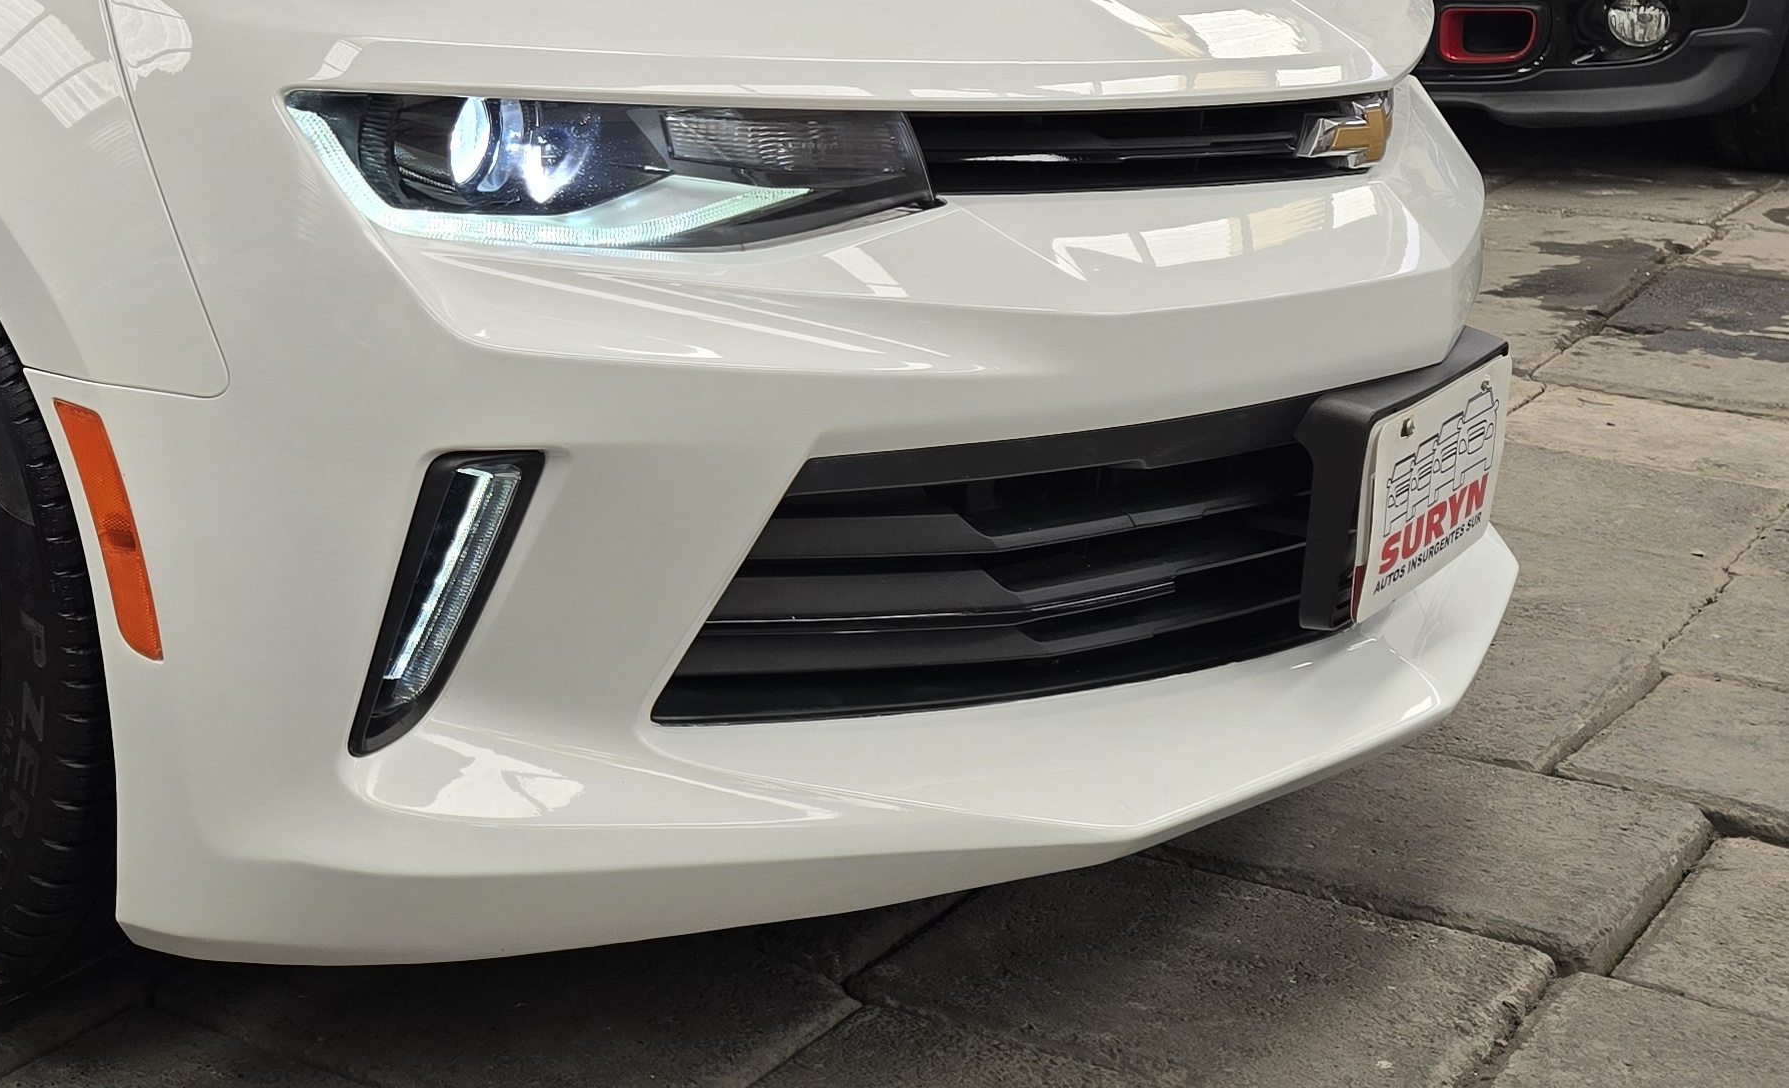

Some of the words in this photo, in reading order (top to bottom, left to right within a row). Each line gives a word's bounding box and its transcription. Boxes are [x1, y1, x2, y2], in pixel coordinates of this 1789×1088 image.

[1373, 564, 1407, 596] AUTOS
[1407, 523, 1465, 574] INSURGENTES
[1465, 511, 1483, 533] SUR
[1378, 472, 1490, 575] SURYN
